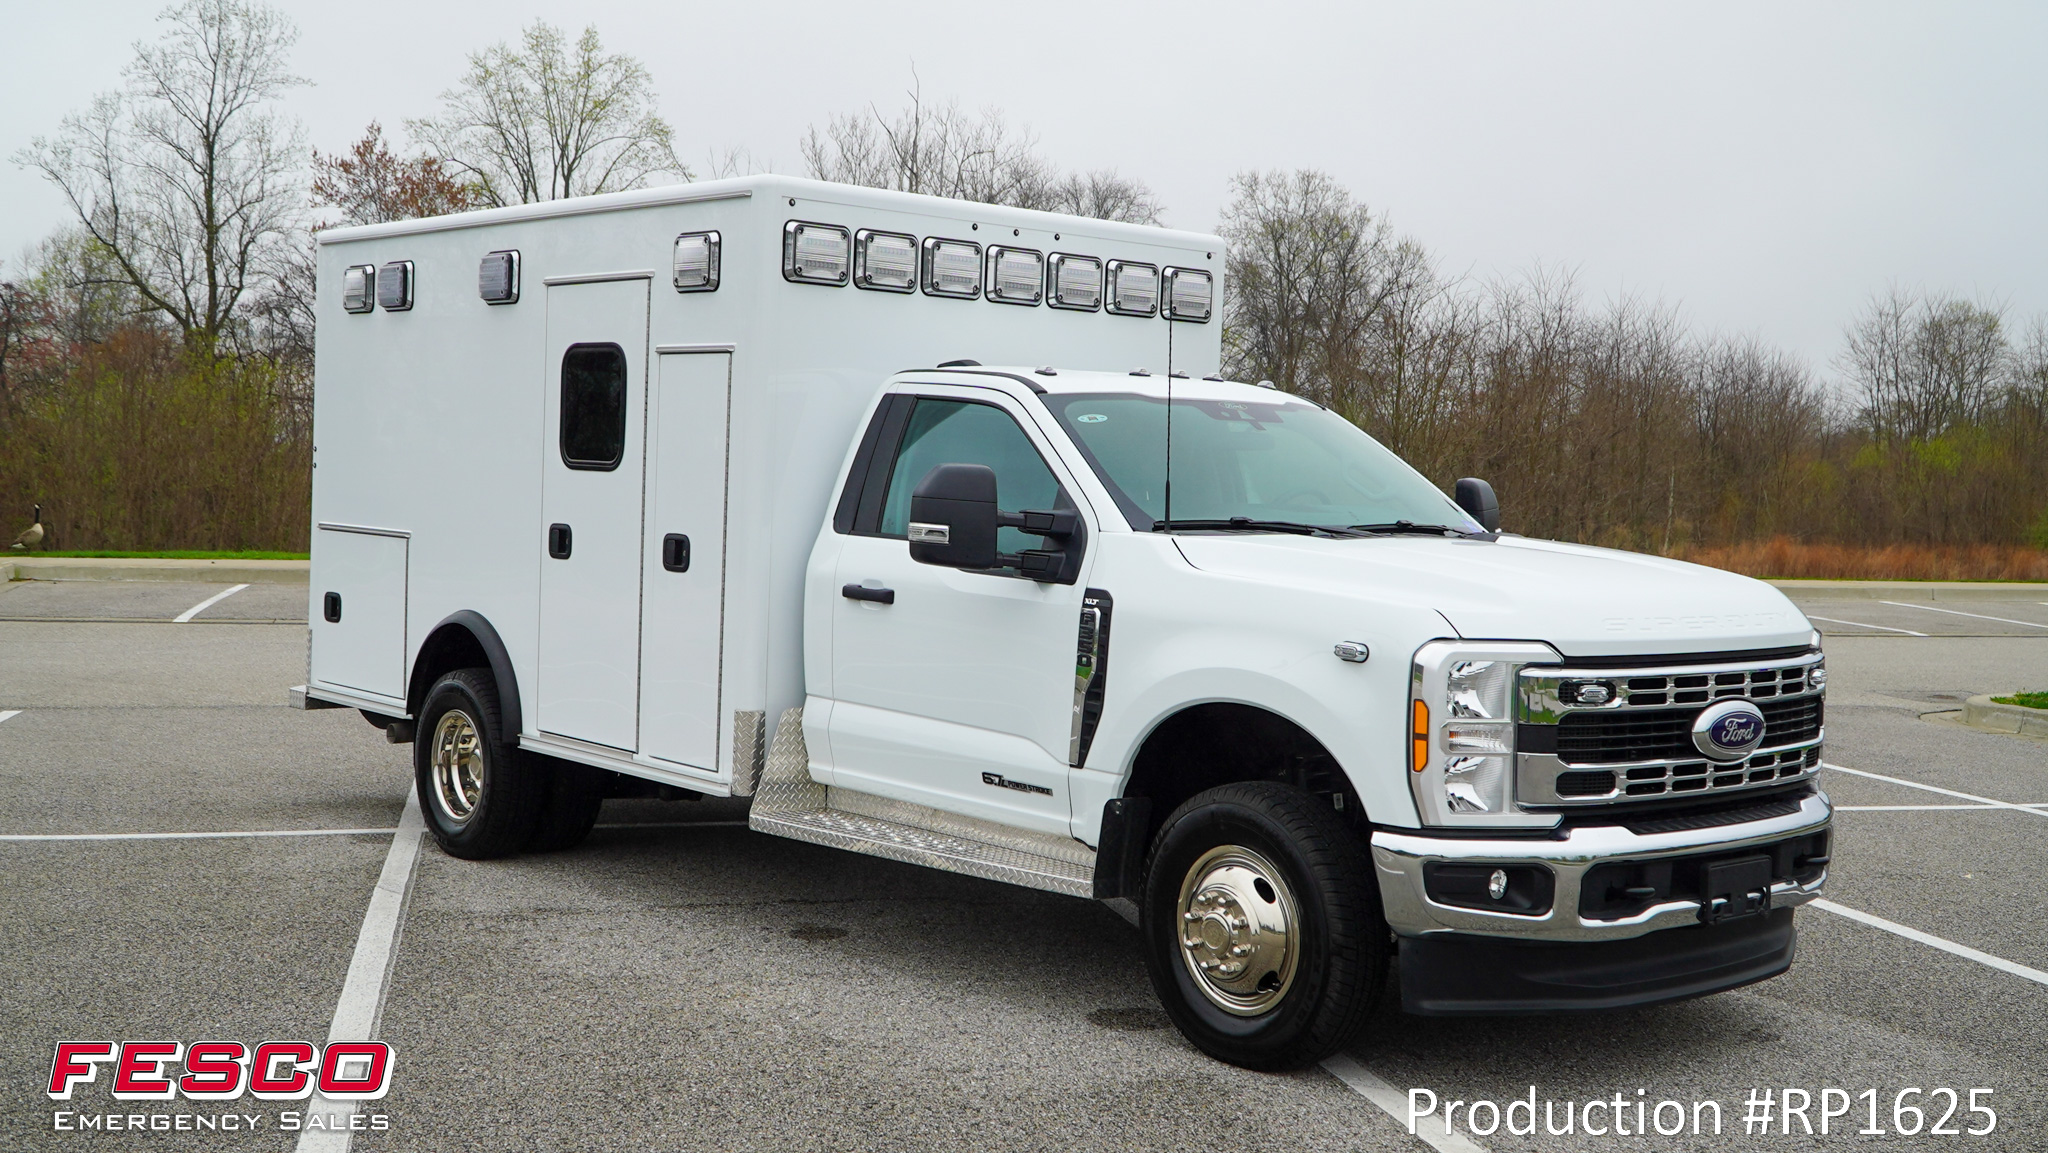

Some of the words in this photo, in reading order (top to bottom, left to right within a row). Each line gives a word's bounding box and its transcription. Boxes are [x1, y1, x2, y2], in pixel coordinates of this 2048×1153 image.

[1084, 598, 1099, 606] XLT
[1721, 717, 1755, 743] Ford
[982, 772, 1008, 788] 6.7L
